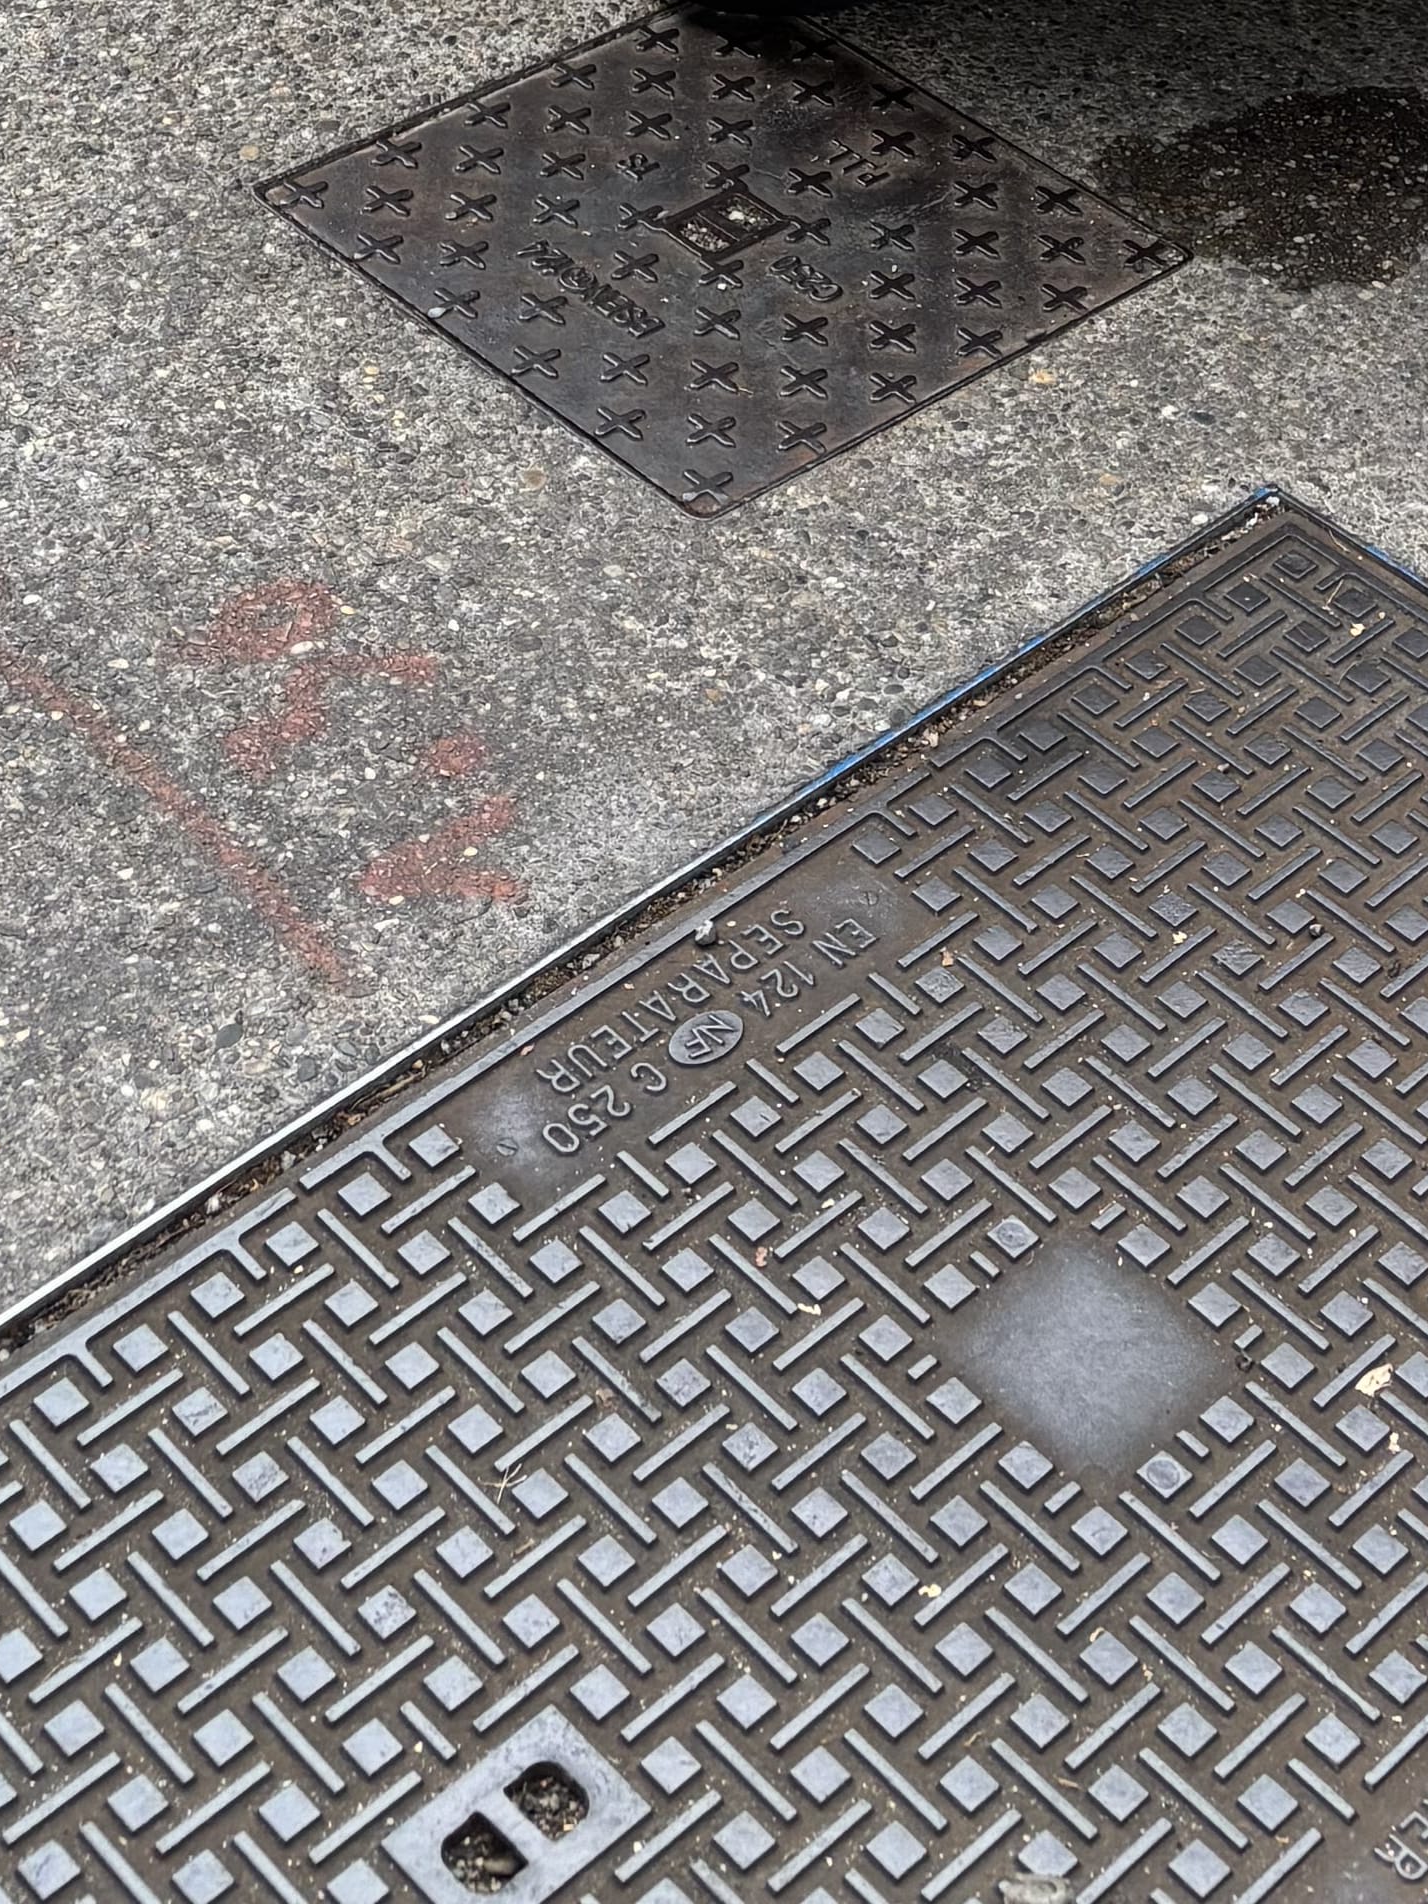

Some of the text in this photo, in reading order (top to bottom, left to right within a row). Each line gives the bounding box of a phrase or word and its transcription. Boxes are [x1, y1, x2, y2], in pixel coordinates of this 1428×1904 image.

[536, 909, 804, 1094] SEPARATEUR
[542, 918, 878, 1154] EN 124 NF C 250
